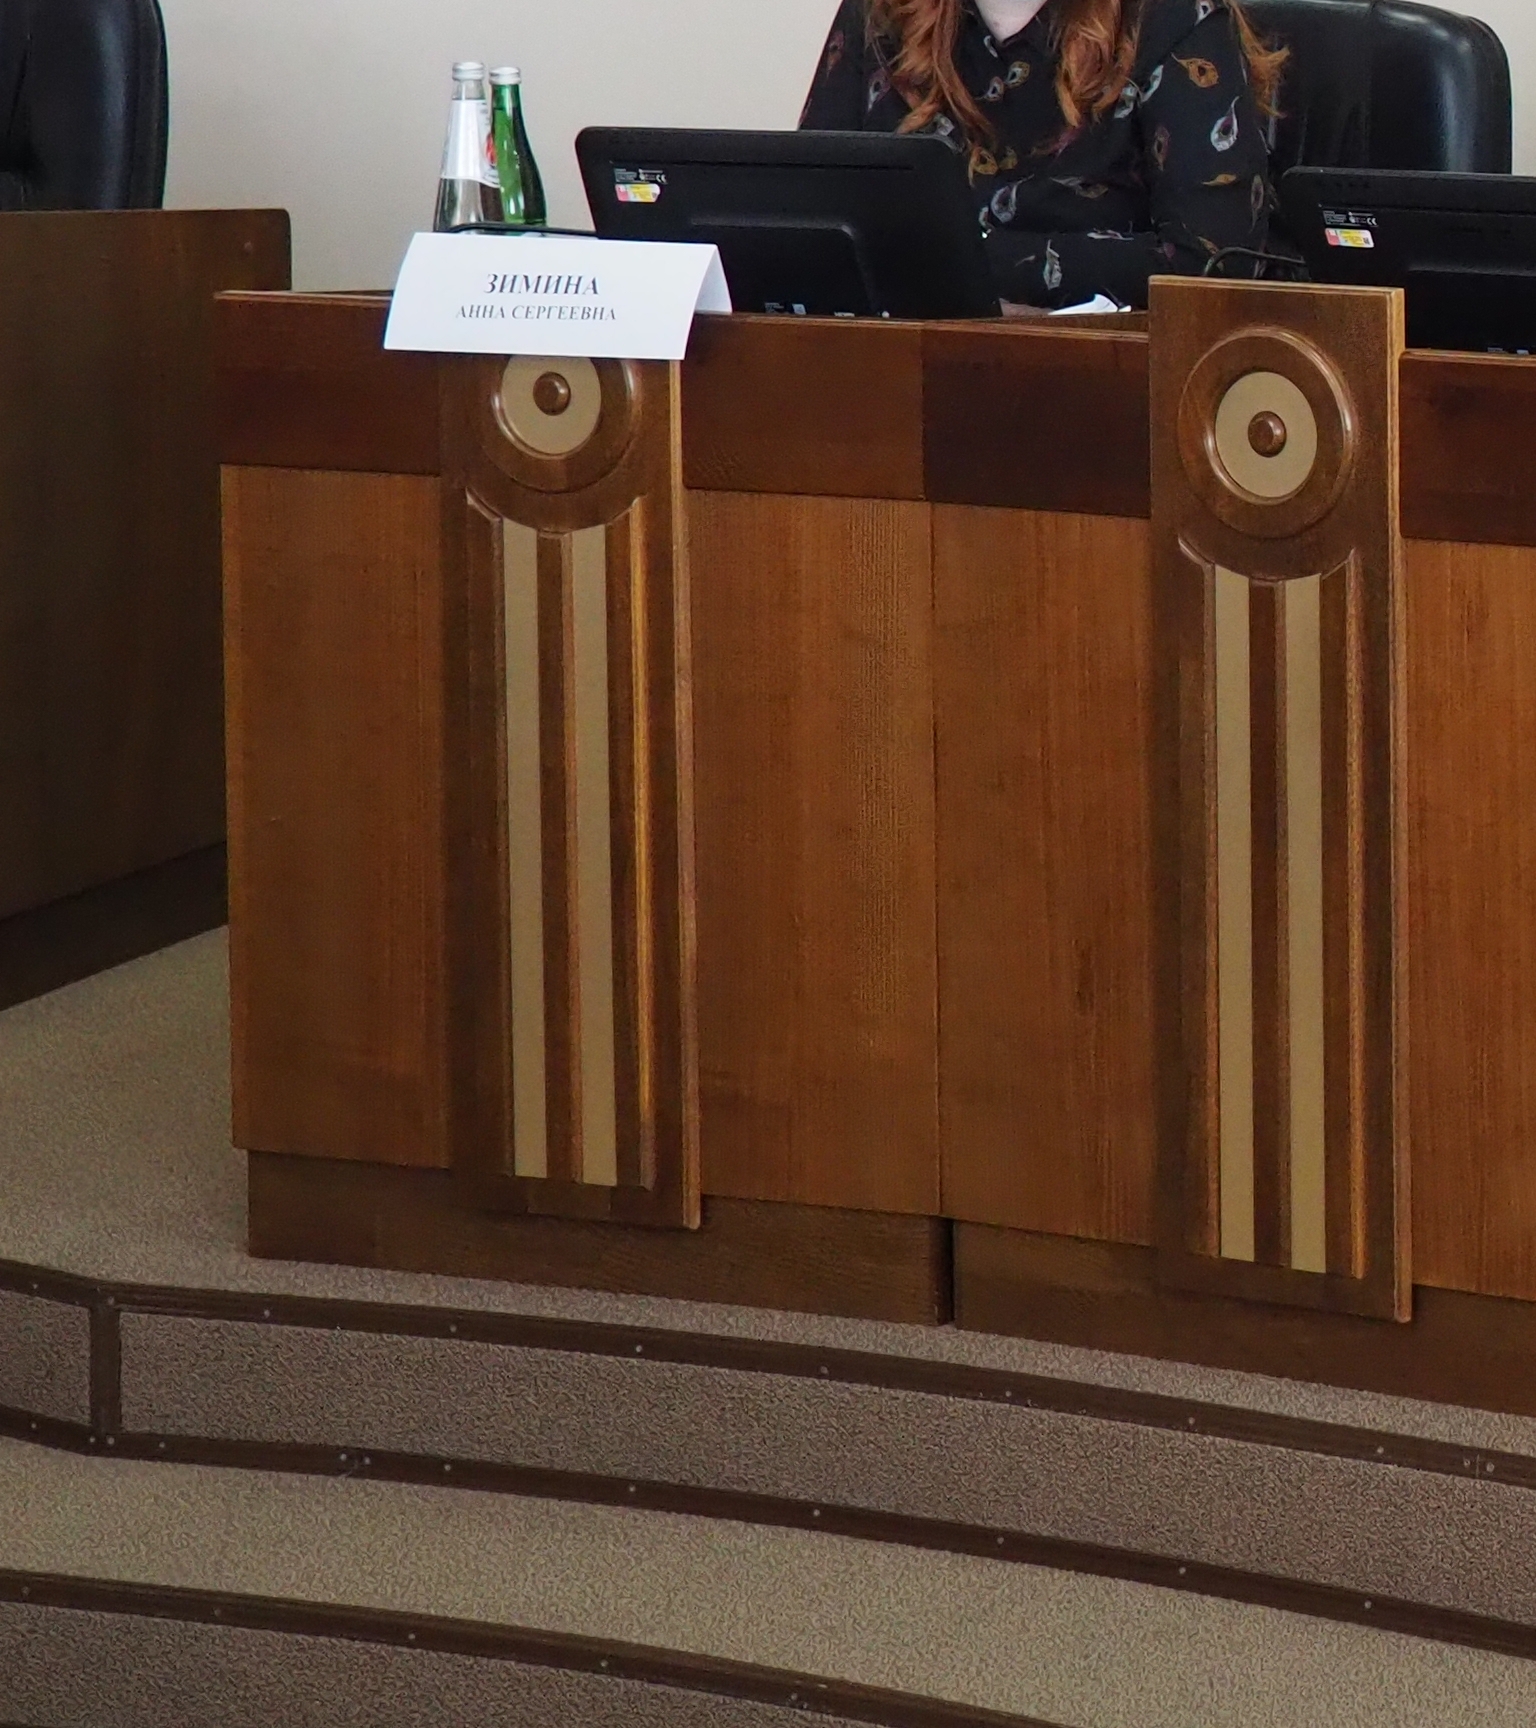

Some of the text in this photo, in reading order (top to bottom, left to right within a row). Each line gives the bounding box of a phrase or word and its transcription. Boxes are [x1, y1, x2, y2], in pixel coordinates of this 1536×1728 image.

[483, 273, 599, 295] ЗИМИНА
[455, 304, 617, 321] АННА СЕРГЕЕВНА
